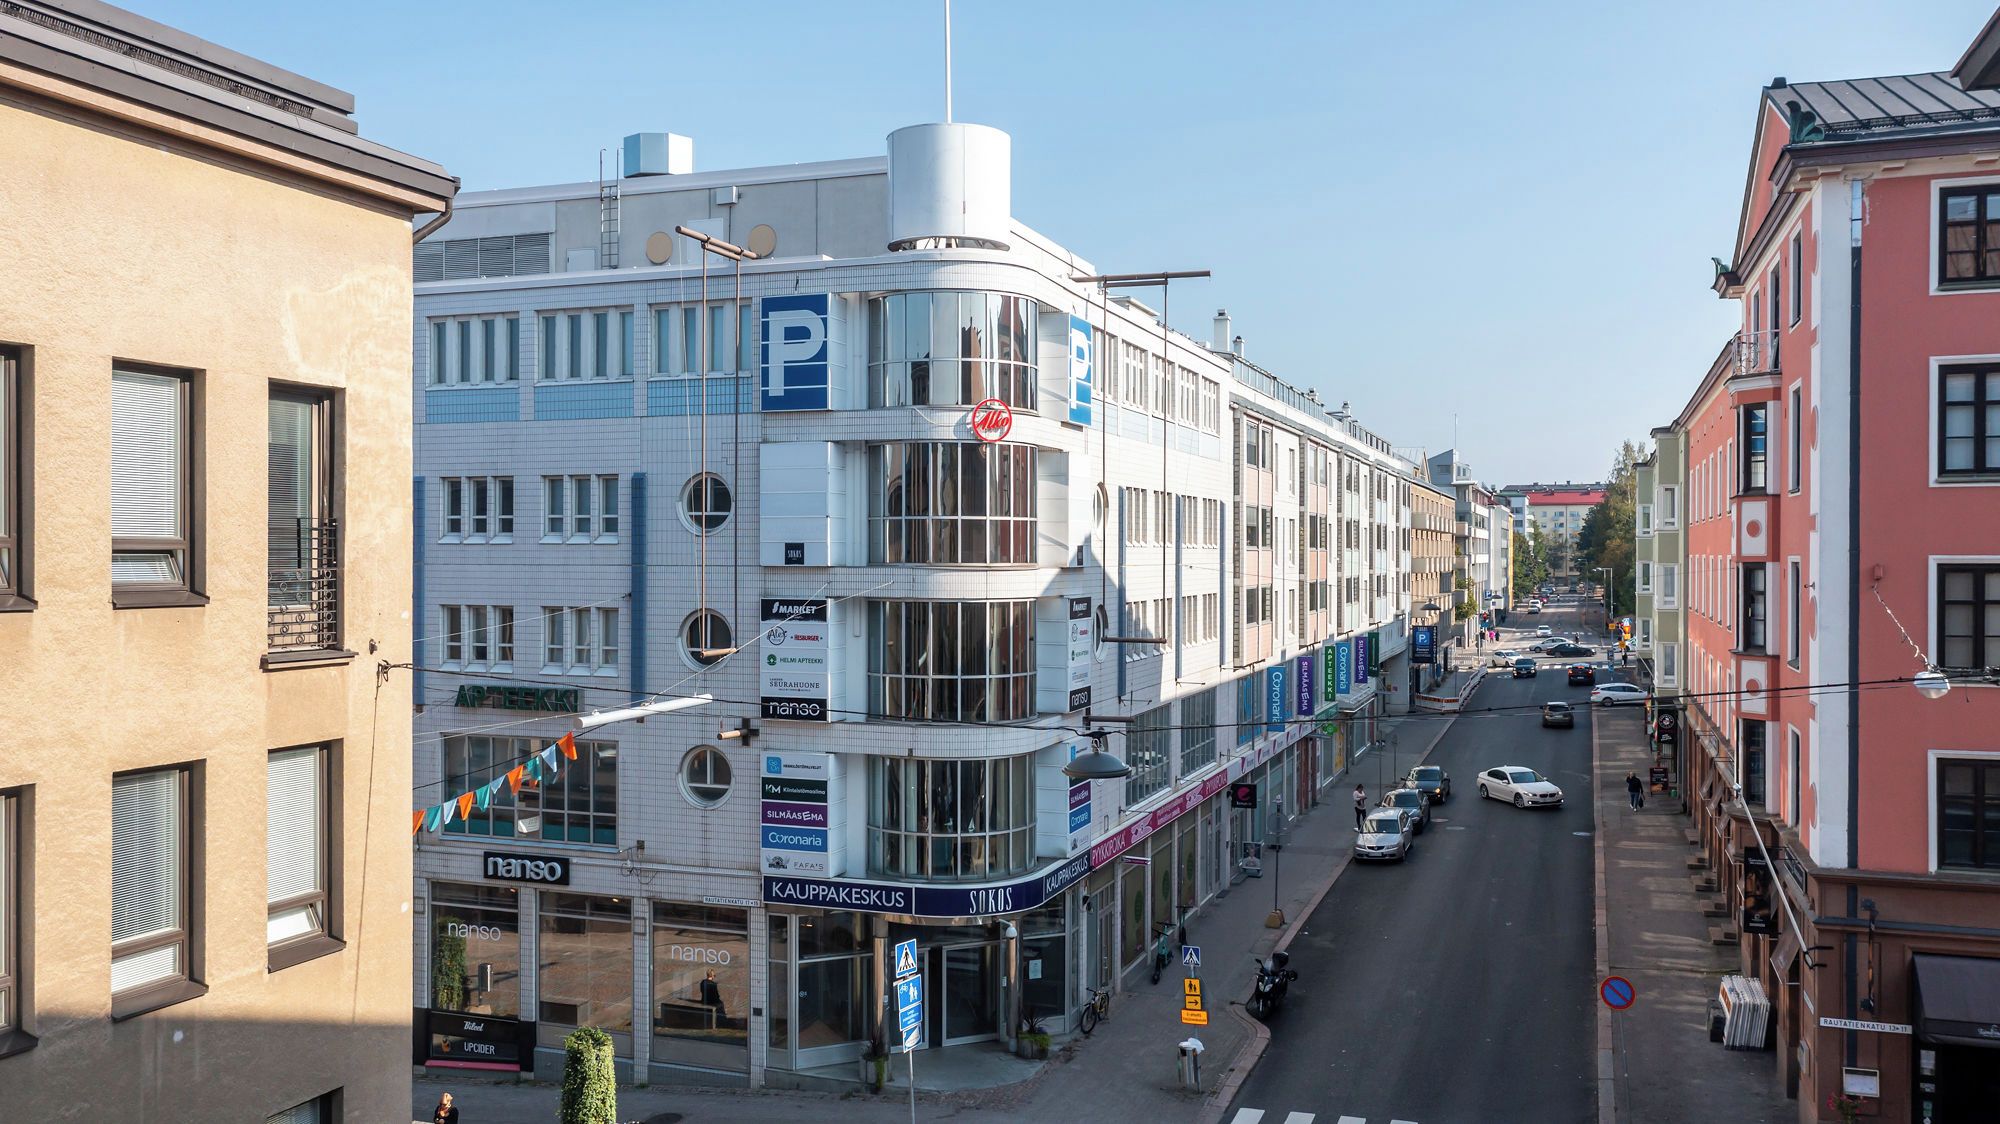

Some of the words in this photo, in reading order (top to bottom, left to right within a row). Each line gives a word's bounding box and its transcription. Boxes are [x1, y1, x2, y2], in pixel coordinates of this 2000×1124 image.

[768, 310, 824, 397] P
[1069, 328, 1089, 410] P
[976, 410, 1009, 430] Alko
[779, 605, 817, 614] MARKET
[1339, 646, 1348, 689] Coronaria
[769, 680, 821, 689] SEURAHUONE
[1301, 661, 1310, 711] SILMÄASEMA
[455, 684, 579, 713] APTEEKKI
[1071, 691, 1088, 707] nanso
[769, 701, 820, 716] nanso
[767, 809, 824, 821] SILMÄASEMA
[1070, 811, 1089, 827] Coronaria
[768, 831, 822, 847] Coronaria
[487, 856, 562, 882] nanso
[793, 861, 824, 871] FAFA'S
[1046, 854, 1089, 894] KAUPPAKESKUS
[771, 881, 905, 908] KAUPPAKESKUS
[969, 887, 1013, 914] SOKOS
[447, 922, 501, 941] nanso
[671, 945, 731, 965] nanso
[1823, 1018, 1886, 1030] RAUTATIENKATU
[463, 1041, 496, 1056] UPCIDER
